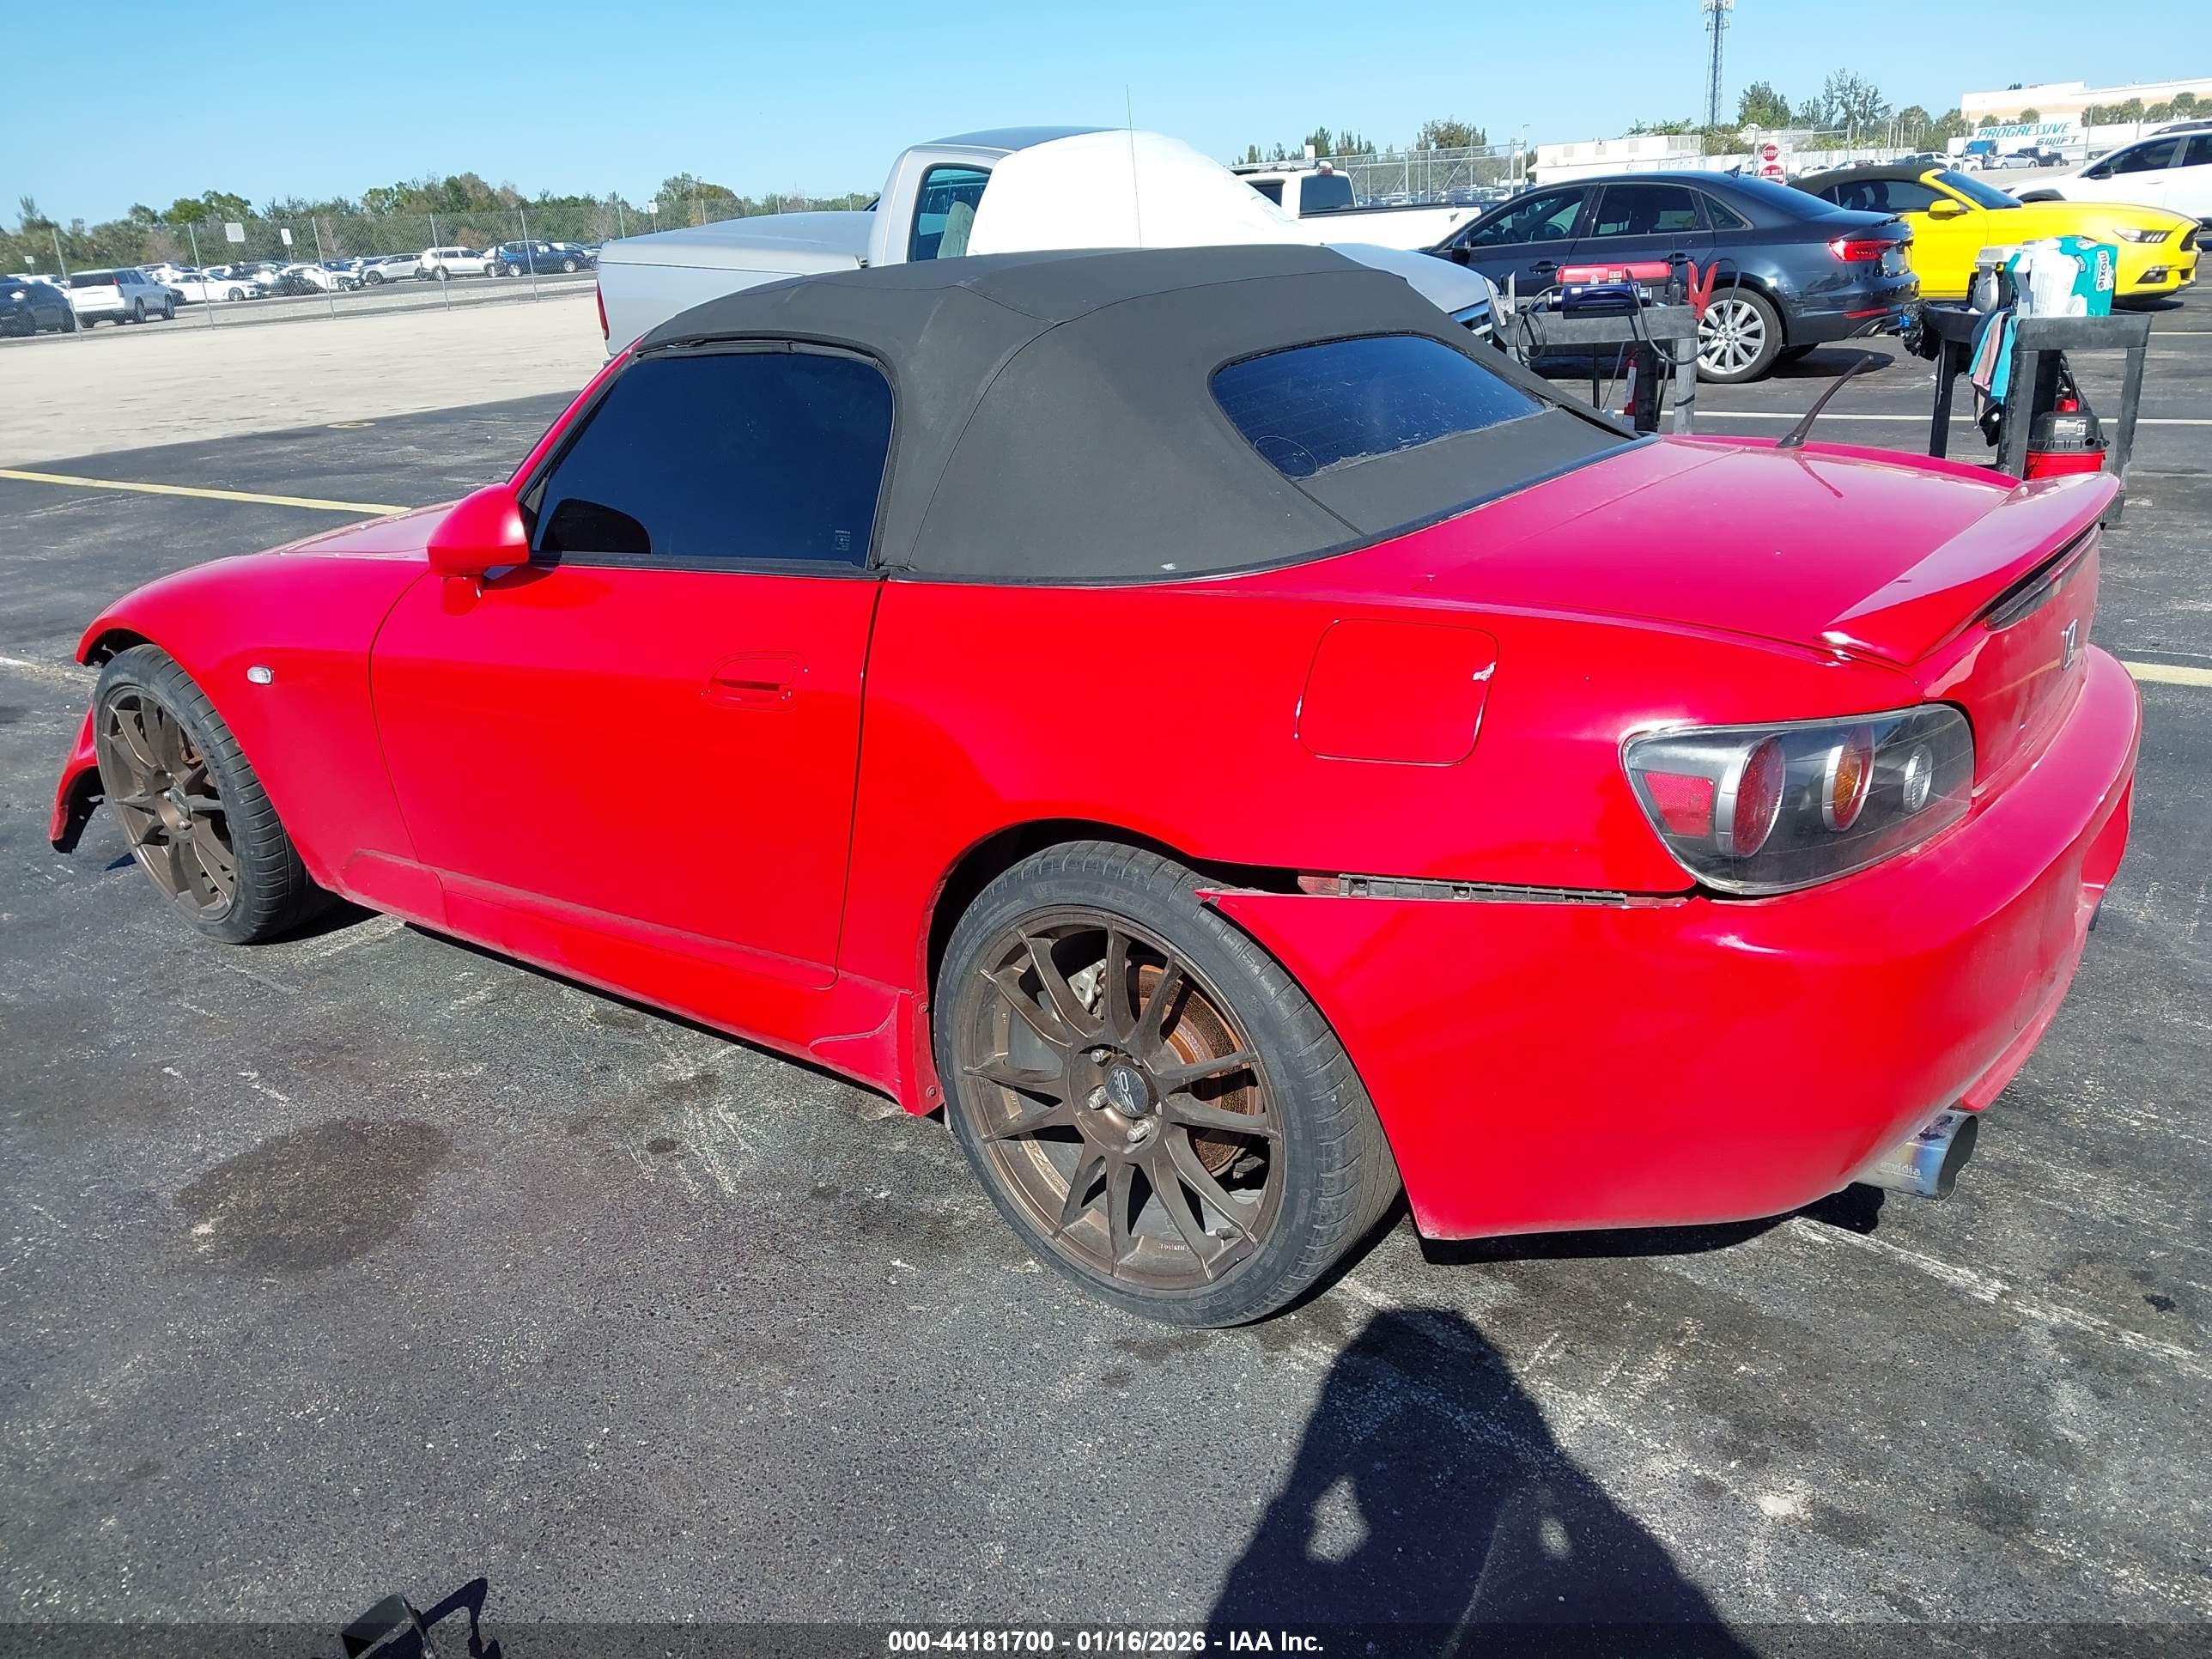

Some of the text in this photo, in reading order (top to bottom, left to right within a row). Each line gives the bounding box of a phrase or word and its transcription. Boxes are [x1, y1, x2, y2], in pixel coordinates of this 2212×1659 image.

[1977, 122, 2072, 139] PROGRESSIVE
[2035, 136, 2079, 146] SWIFT
[2099, 252, 2108, 289] moxie
